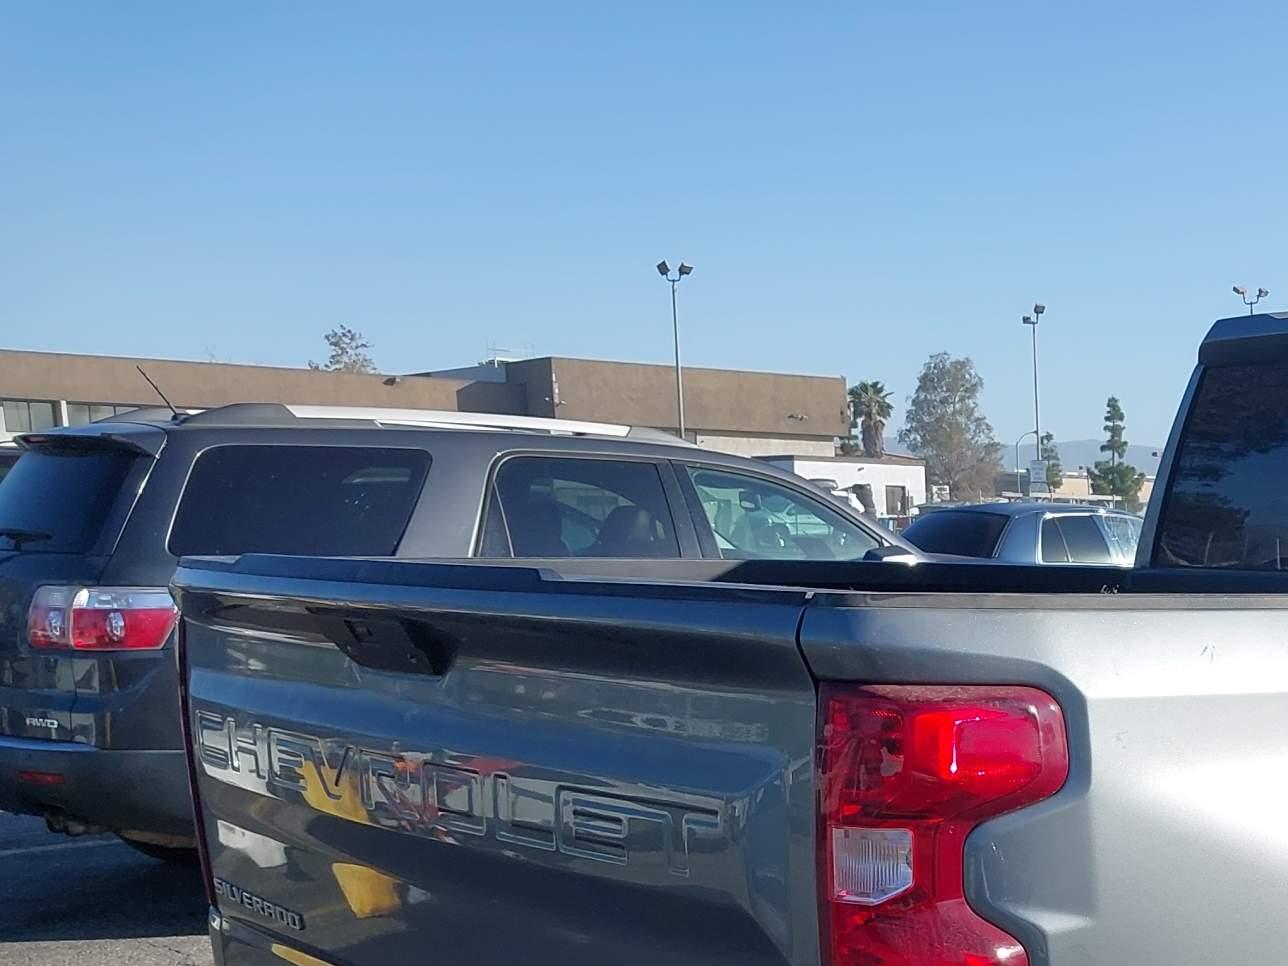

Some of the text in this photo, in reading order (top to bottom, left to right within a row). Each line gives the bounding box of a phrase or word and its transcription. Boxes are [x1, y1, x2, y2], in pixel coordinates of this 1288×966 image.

[25, 717, 58, 729] AWD
[197, 710, 724, 878] CHEVROLET
[213, 877, 305, 930] SILVERADO
